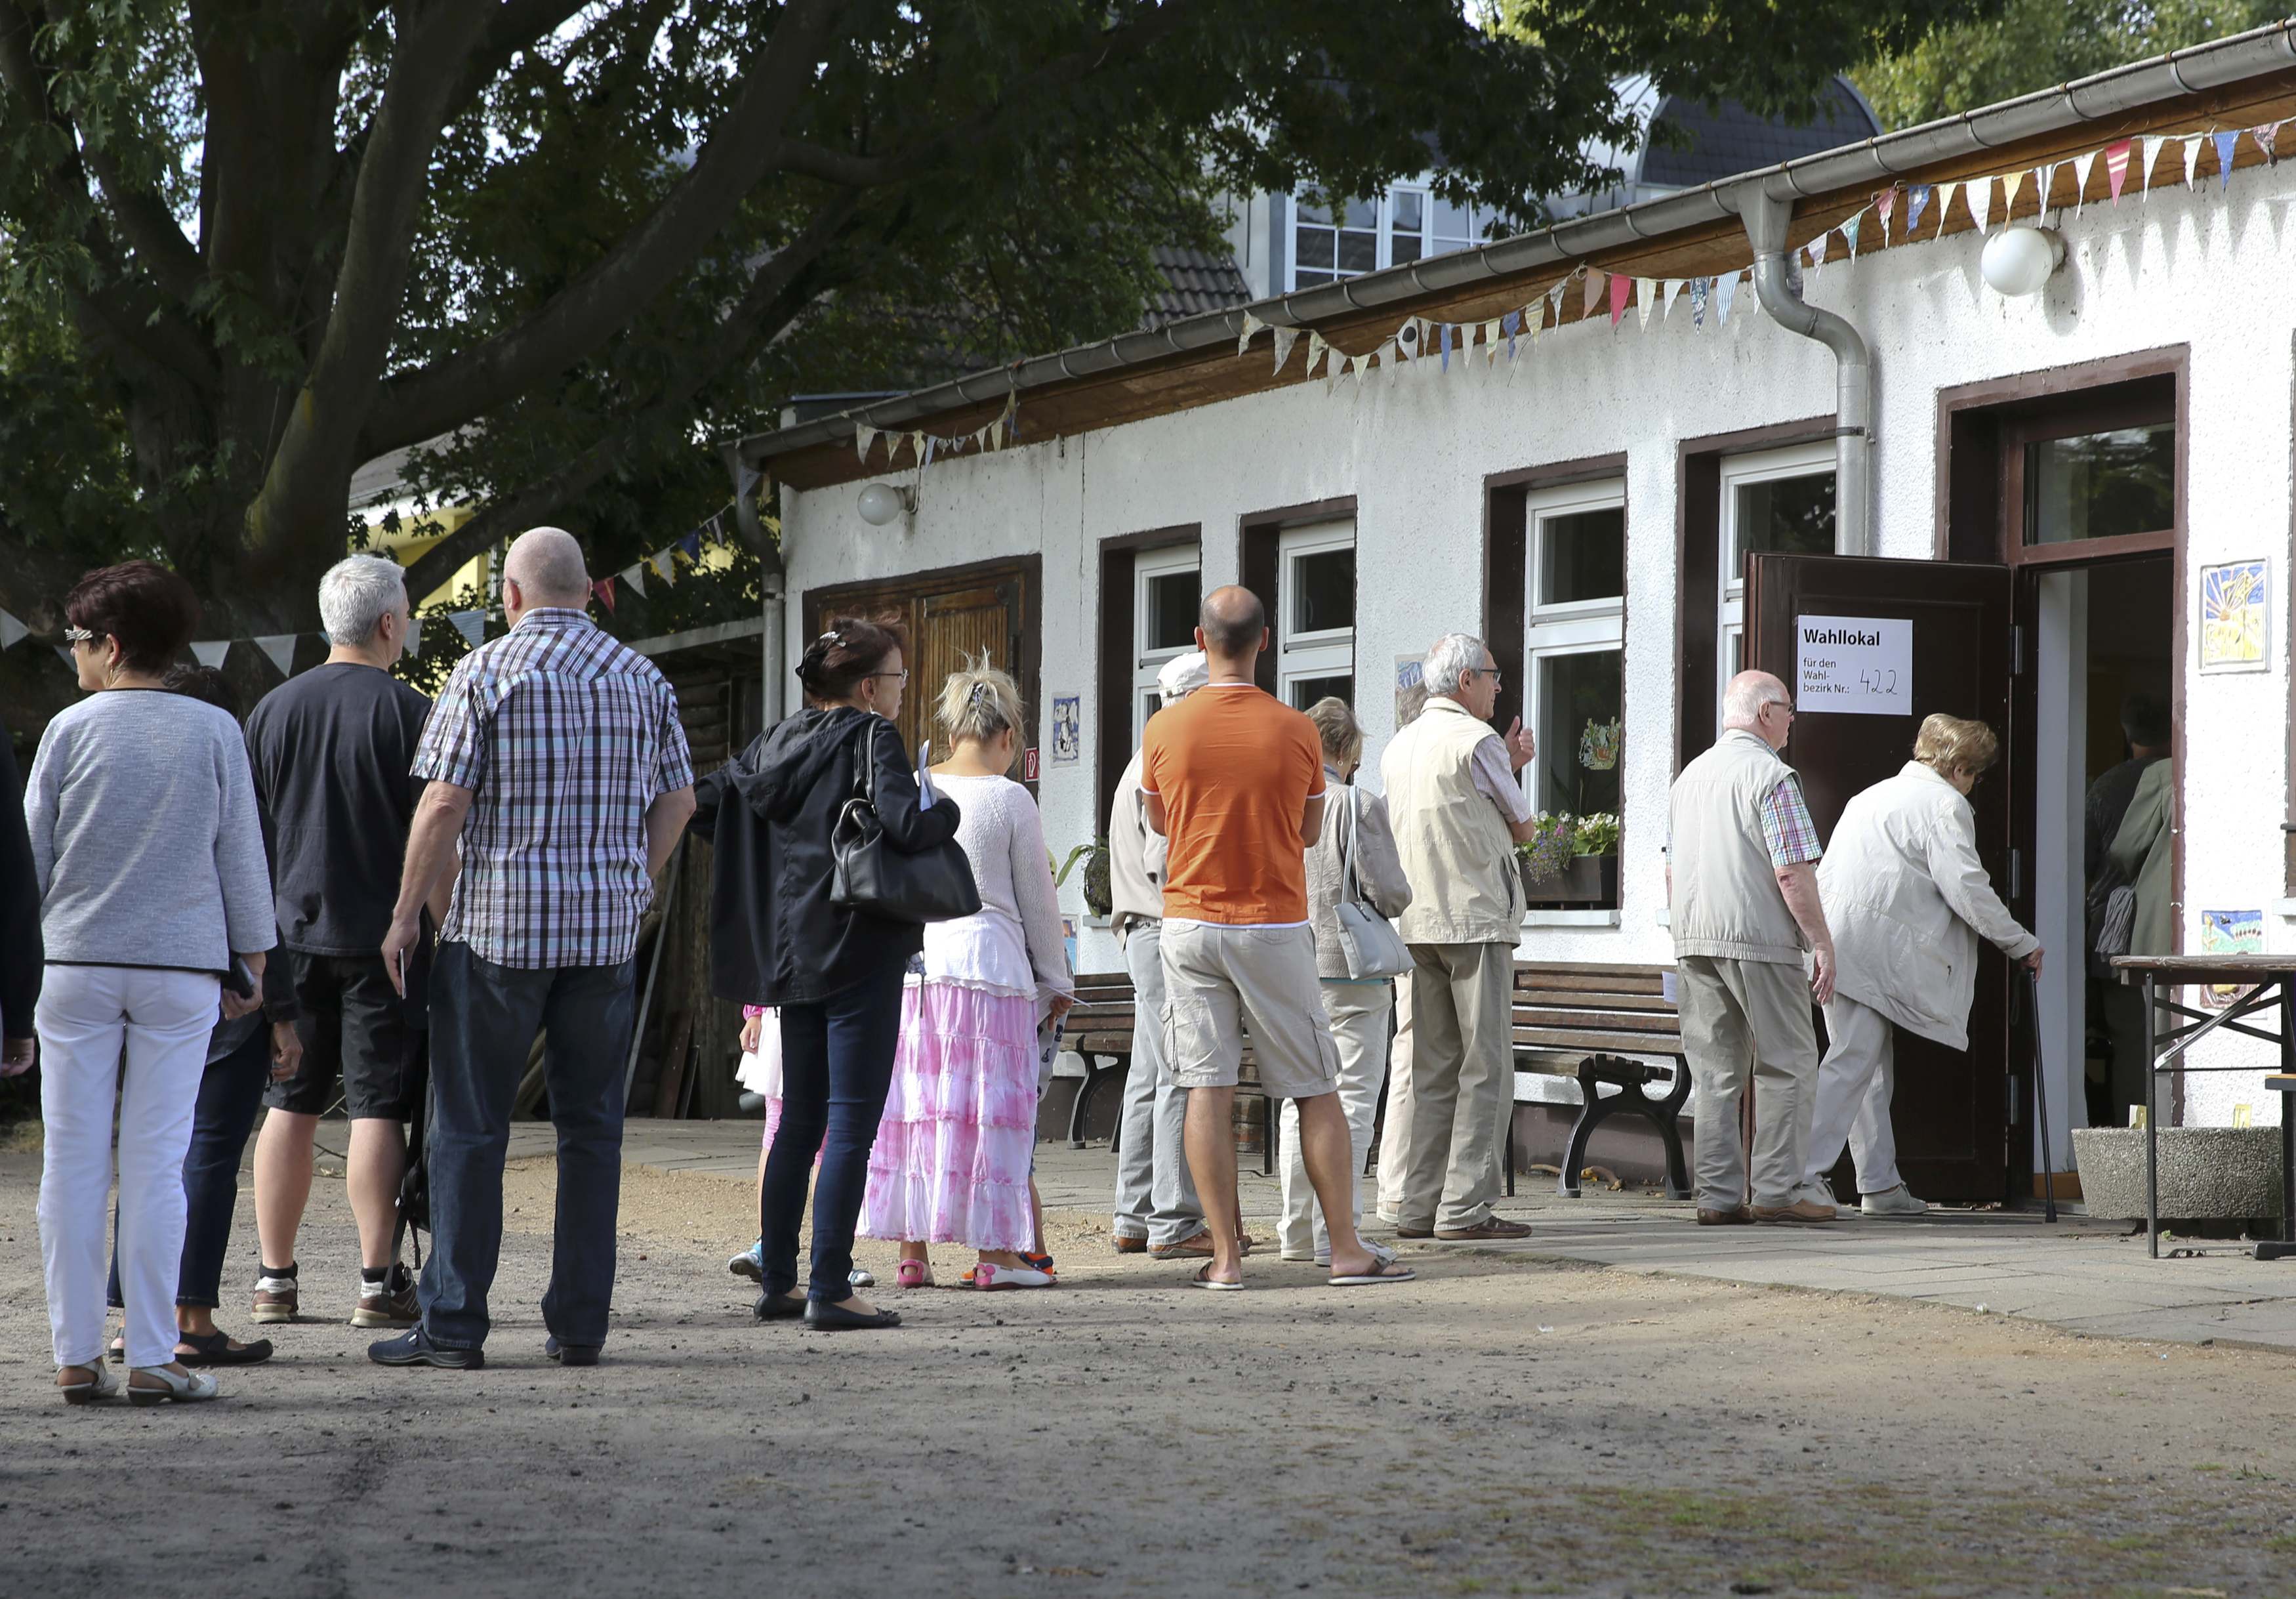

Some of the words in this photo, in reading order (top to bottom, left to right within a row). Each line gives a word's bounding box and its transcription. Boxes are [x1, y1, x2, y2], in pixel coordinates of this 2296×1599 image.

[1804, 629, 1880, 646] Wahllokal
[1803, 657, 1816, 667] für
[1818, 658, 1836, 668] den
[1803, 671, 1830, 680] Wahl-
[1860, 669, 1898, 695] 422
[1803, 683, 1832, 693] bezirk
[1834, 684, 1850, 694] Nr.:
